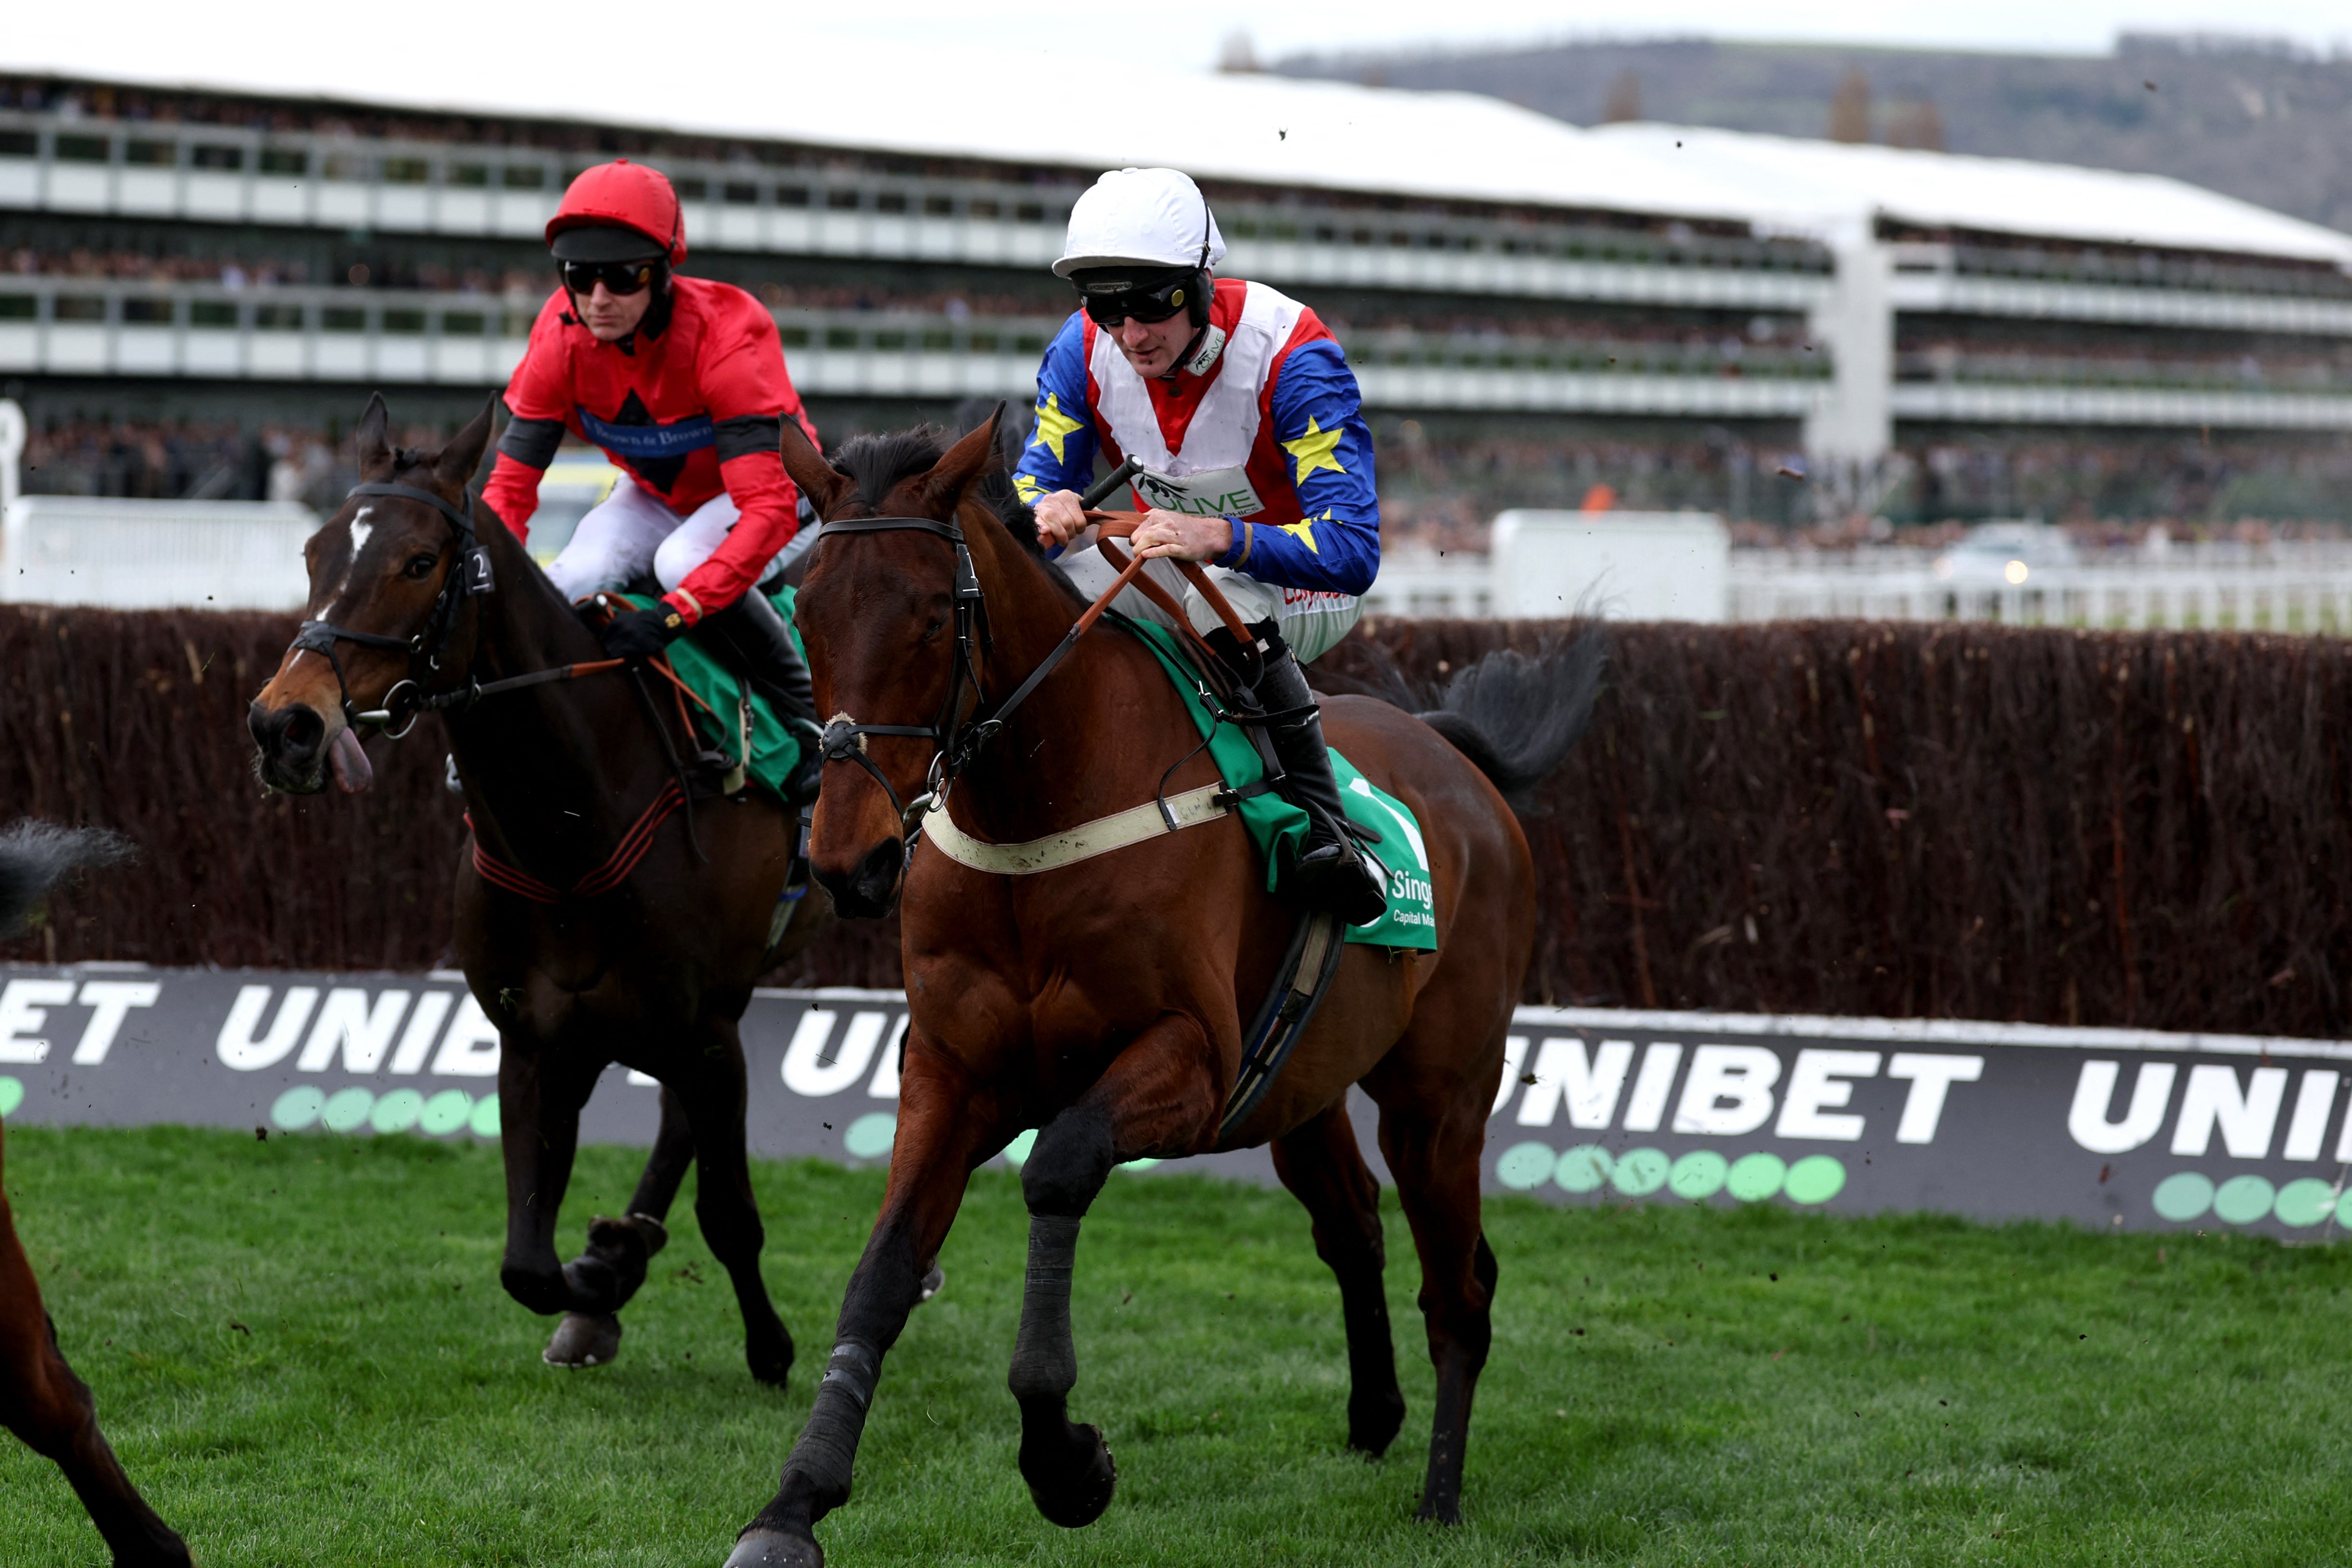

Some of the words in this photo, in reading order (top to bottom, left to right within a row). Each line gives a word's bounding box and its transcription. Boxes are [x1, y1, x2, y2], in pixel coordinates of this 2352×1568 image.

[1201, 333, 1224, 368] OLIVE
[657, 426, 712, 446] Brown
[1151, 489, 1256, 514] OLIVE
[473, 553, 488, 578] 2
[1393, 909, 1421, 926] Capital
[0, 979, 160, 1065] ET
[2068, 1060, 2352, 1163] UNI
